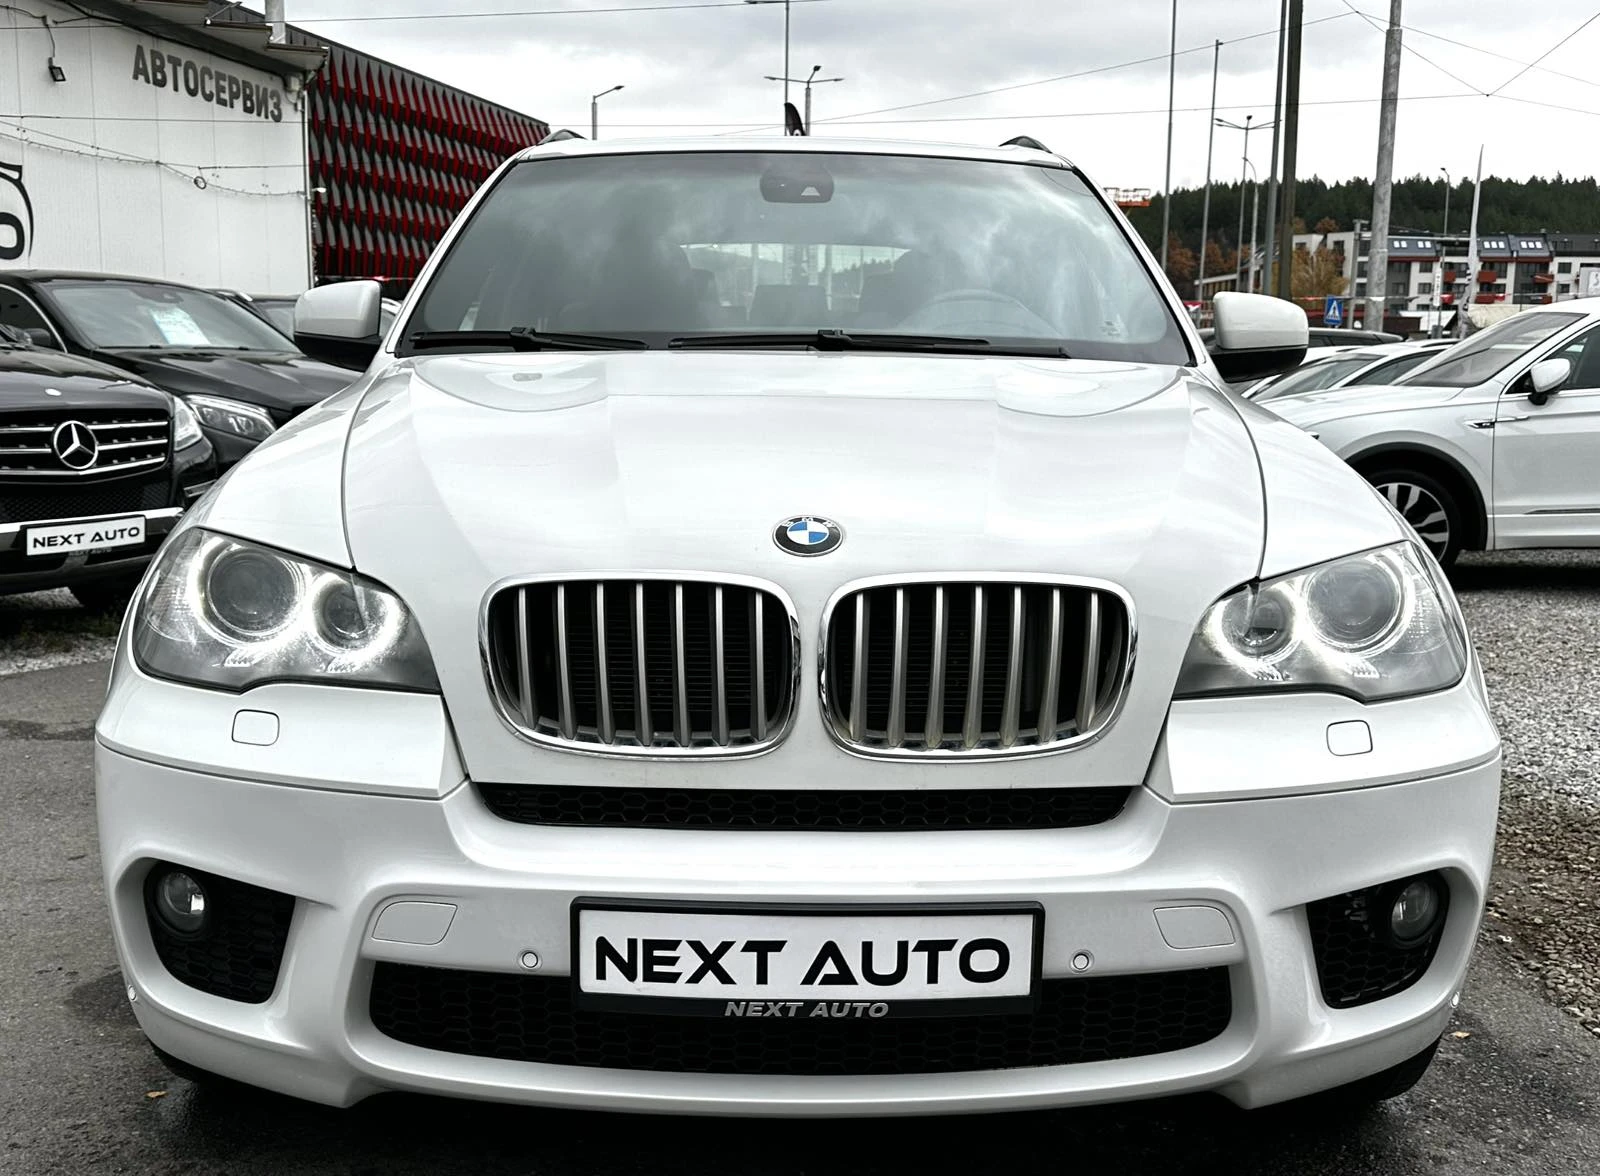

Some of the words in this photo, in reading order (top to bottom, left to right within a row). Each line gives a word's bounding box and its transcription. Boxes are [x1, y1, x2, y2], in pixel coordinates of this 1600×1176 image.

[132, 44, 283, 123] АВТОСЕРВИЗ
[33, 532, 85, 548] NEXT
[90, 526, 140, 543] AUTO
[595, 936, 788, 985] NEXT
[800, 937, 1011, 987] AUTO
[724, 1002, 804, 1017] NEXT
[809, 1002, 889, 1018] AUTO
